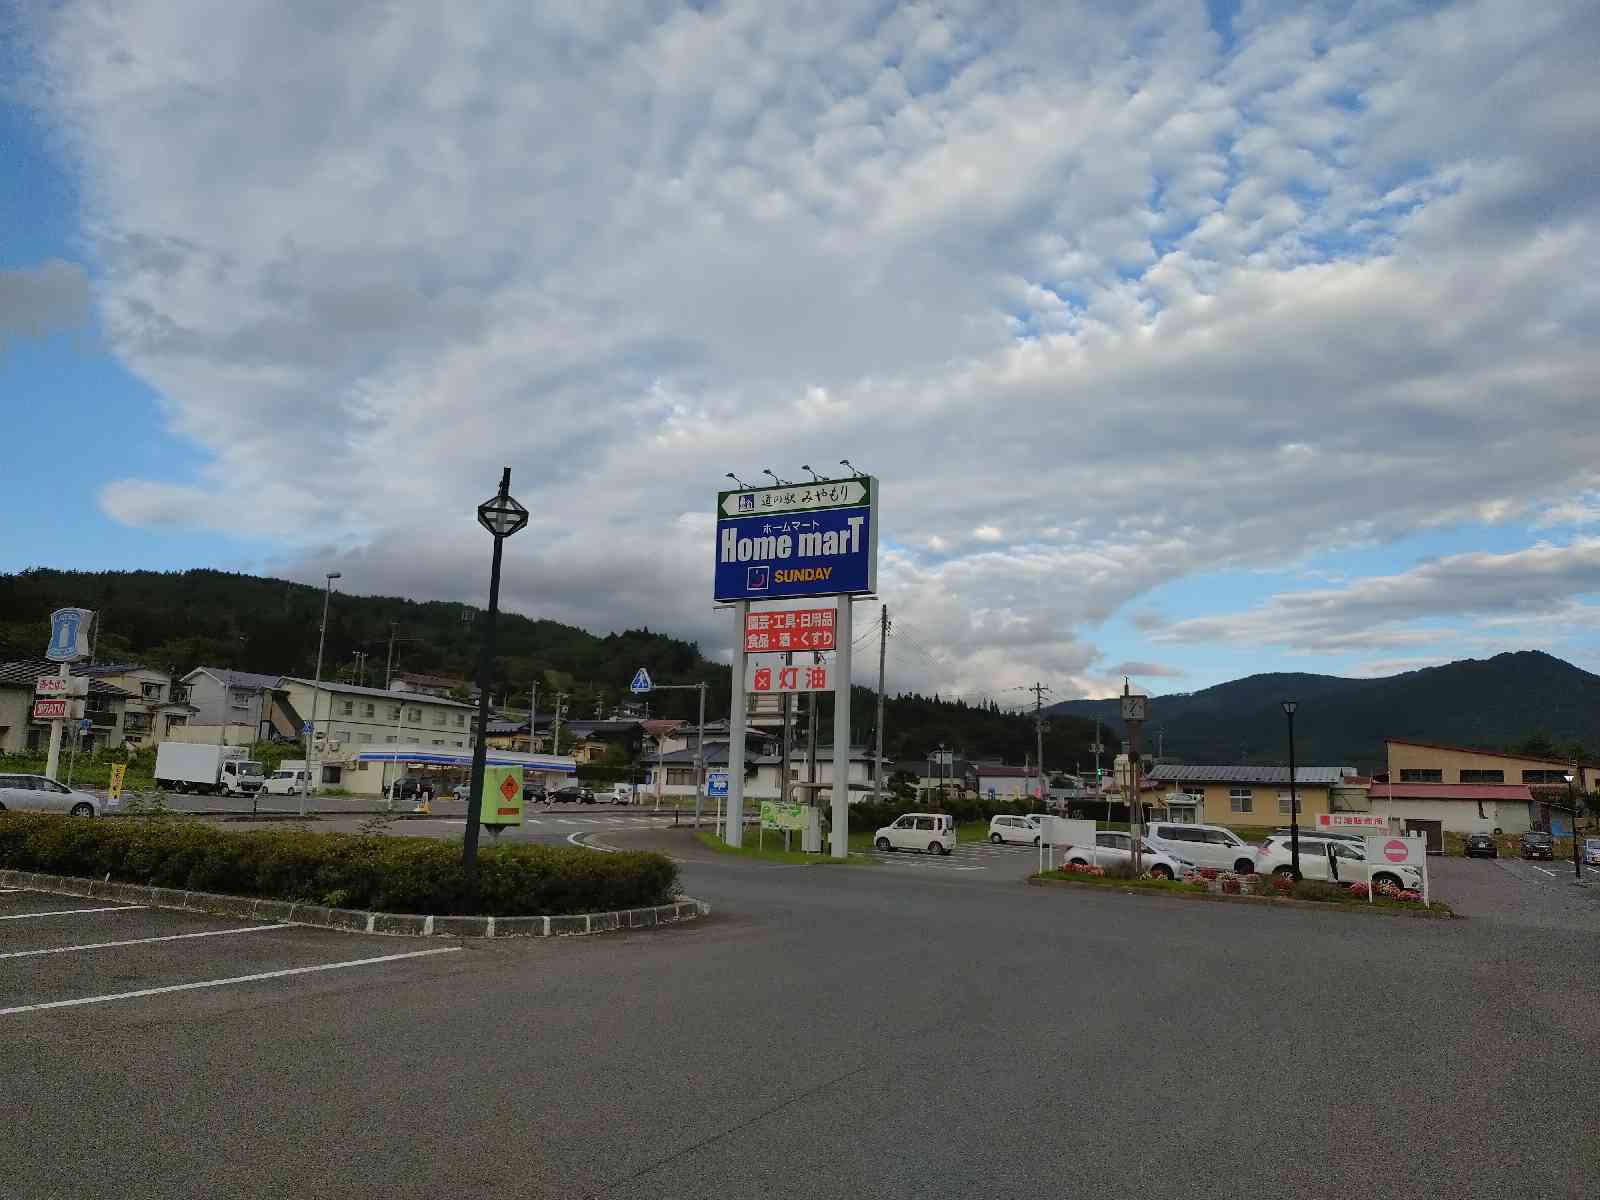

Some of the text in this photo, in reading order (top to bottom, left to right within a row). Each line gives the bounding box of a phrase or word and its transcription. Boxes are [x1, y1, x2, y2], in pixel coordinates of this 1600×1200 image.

[761, 485, 848, 507] 道の駅 みやもり
[763, 519, 819, 534] ホームマート
[721, 527, 793, 563] Home
[774, 566, 832, 583] SUNDAY
[779, 667, 825, 689] 灯油
